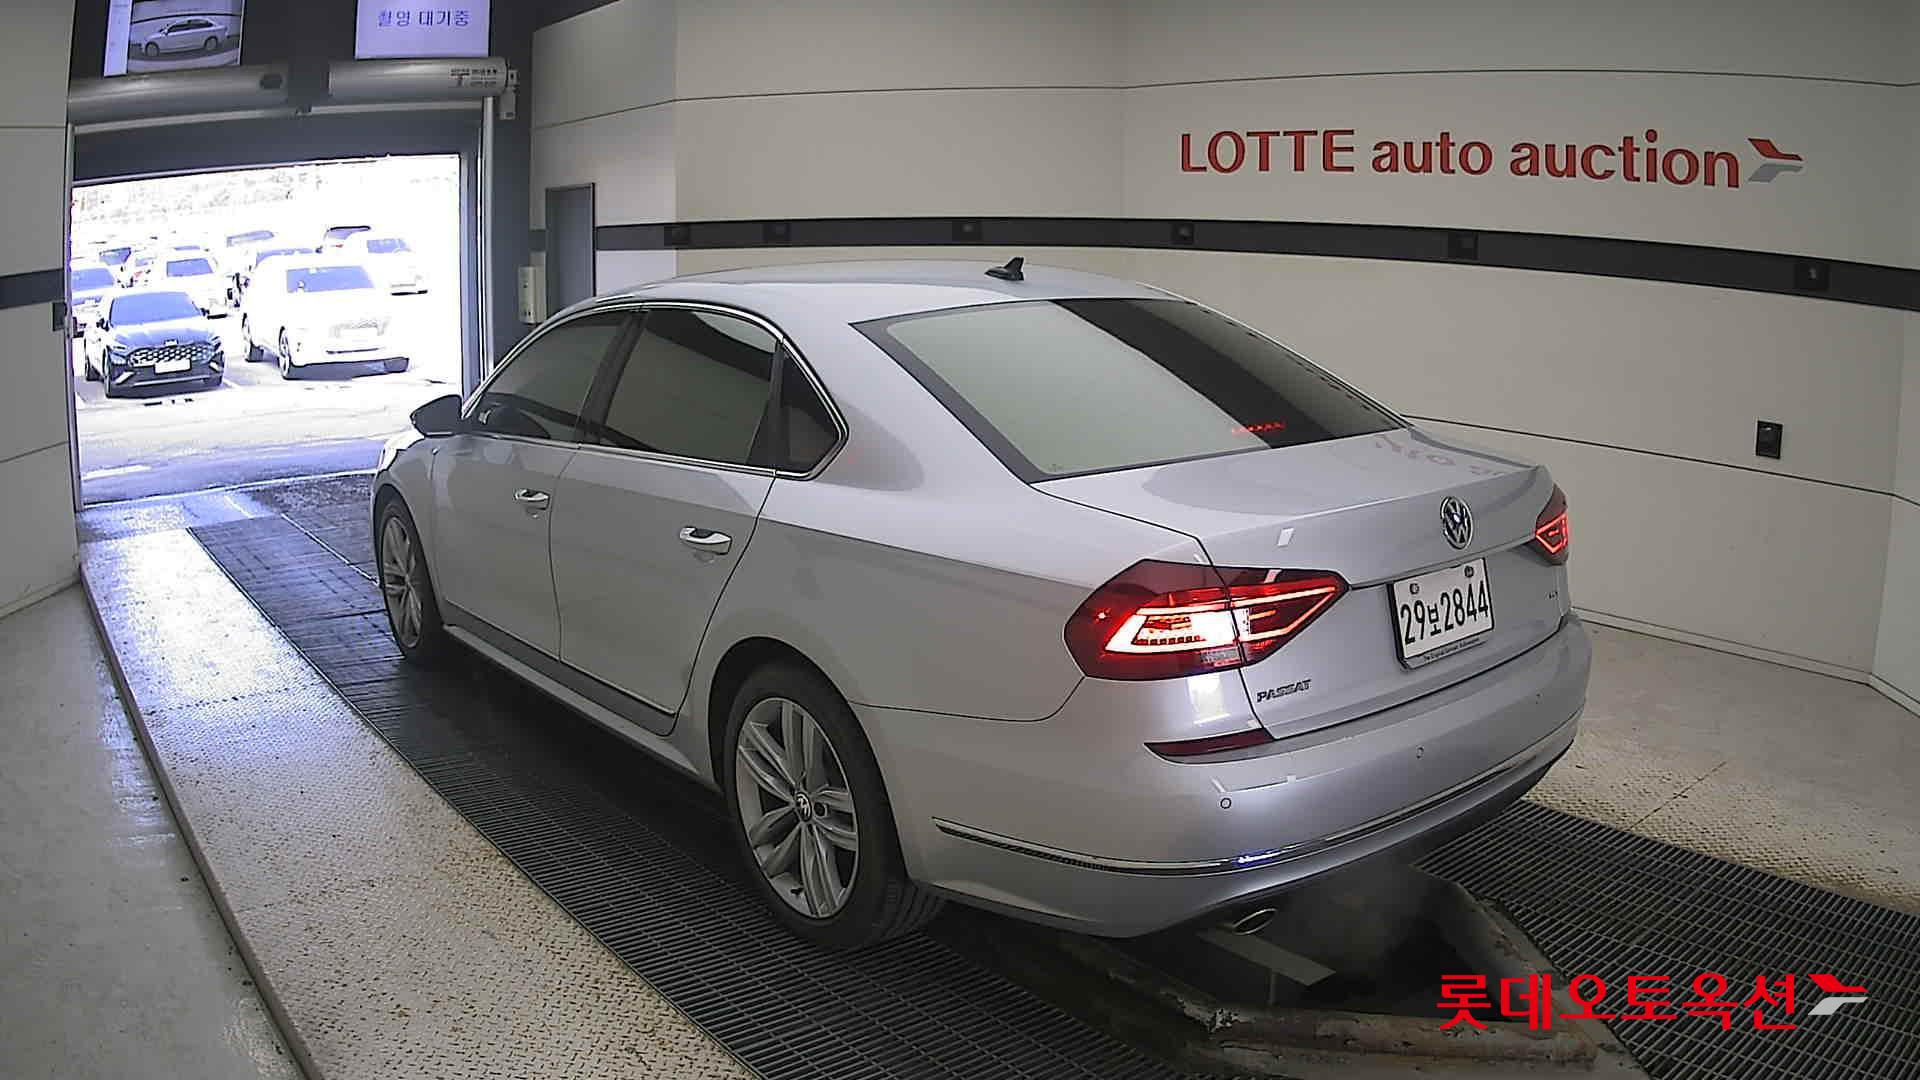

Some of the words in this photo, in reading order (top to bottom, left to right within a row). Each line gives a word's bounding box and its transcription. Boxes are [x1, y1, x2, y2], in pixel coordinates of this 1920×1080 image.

[418, 9, 469, 27] 대기중
[1180, 129, 1355, 173] LOTTE
[1371, 131, 1494, 177] auto
[1509, 128, 1741, 189] auction
[1400, 580, 1489, 645] 29보2844
[1256, 678, 1312, 703] PASSAT
